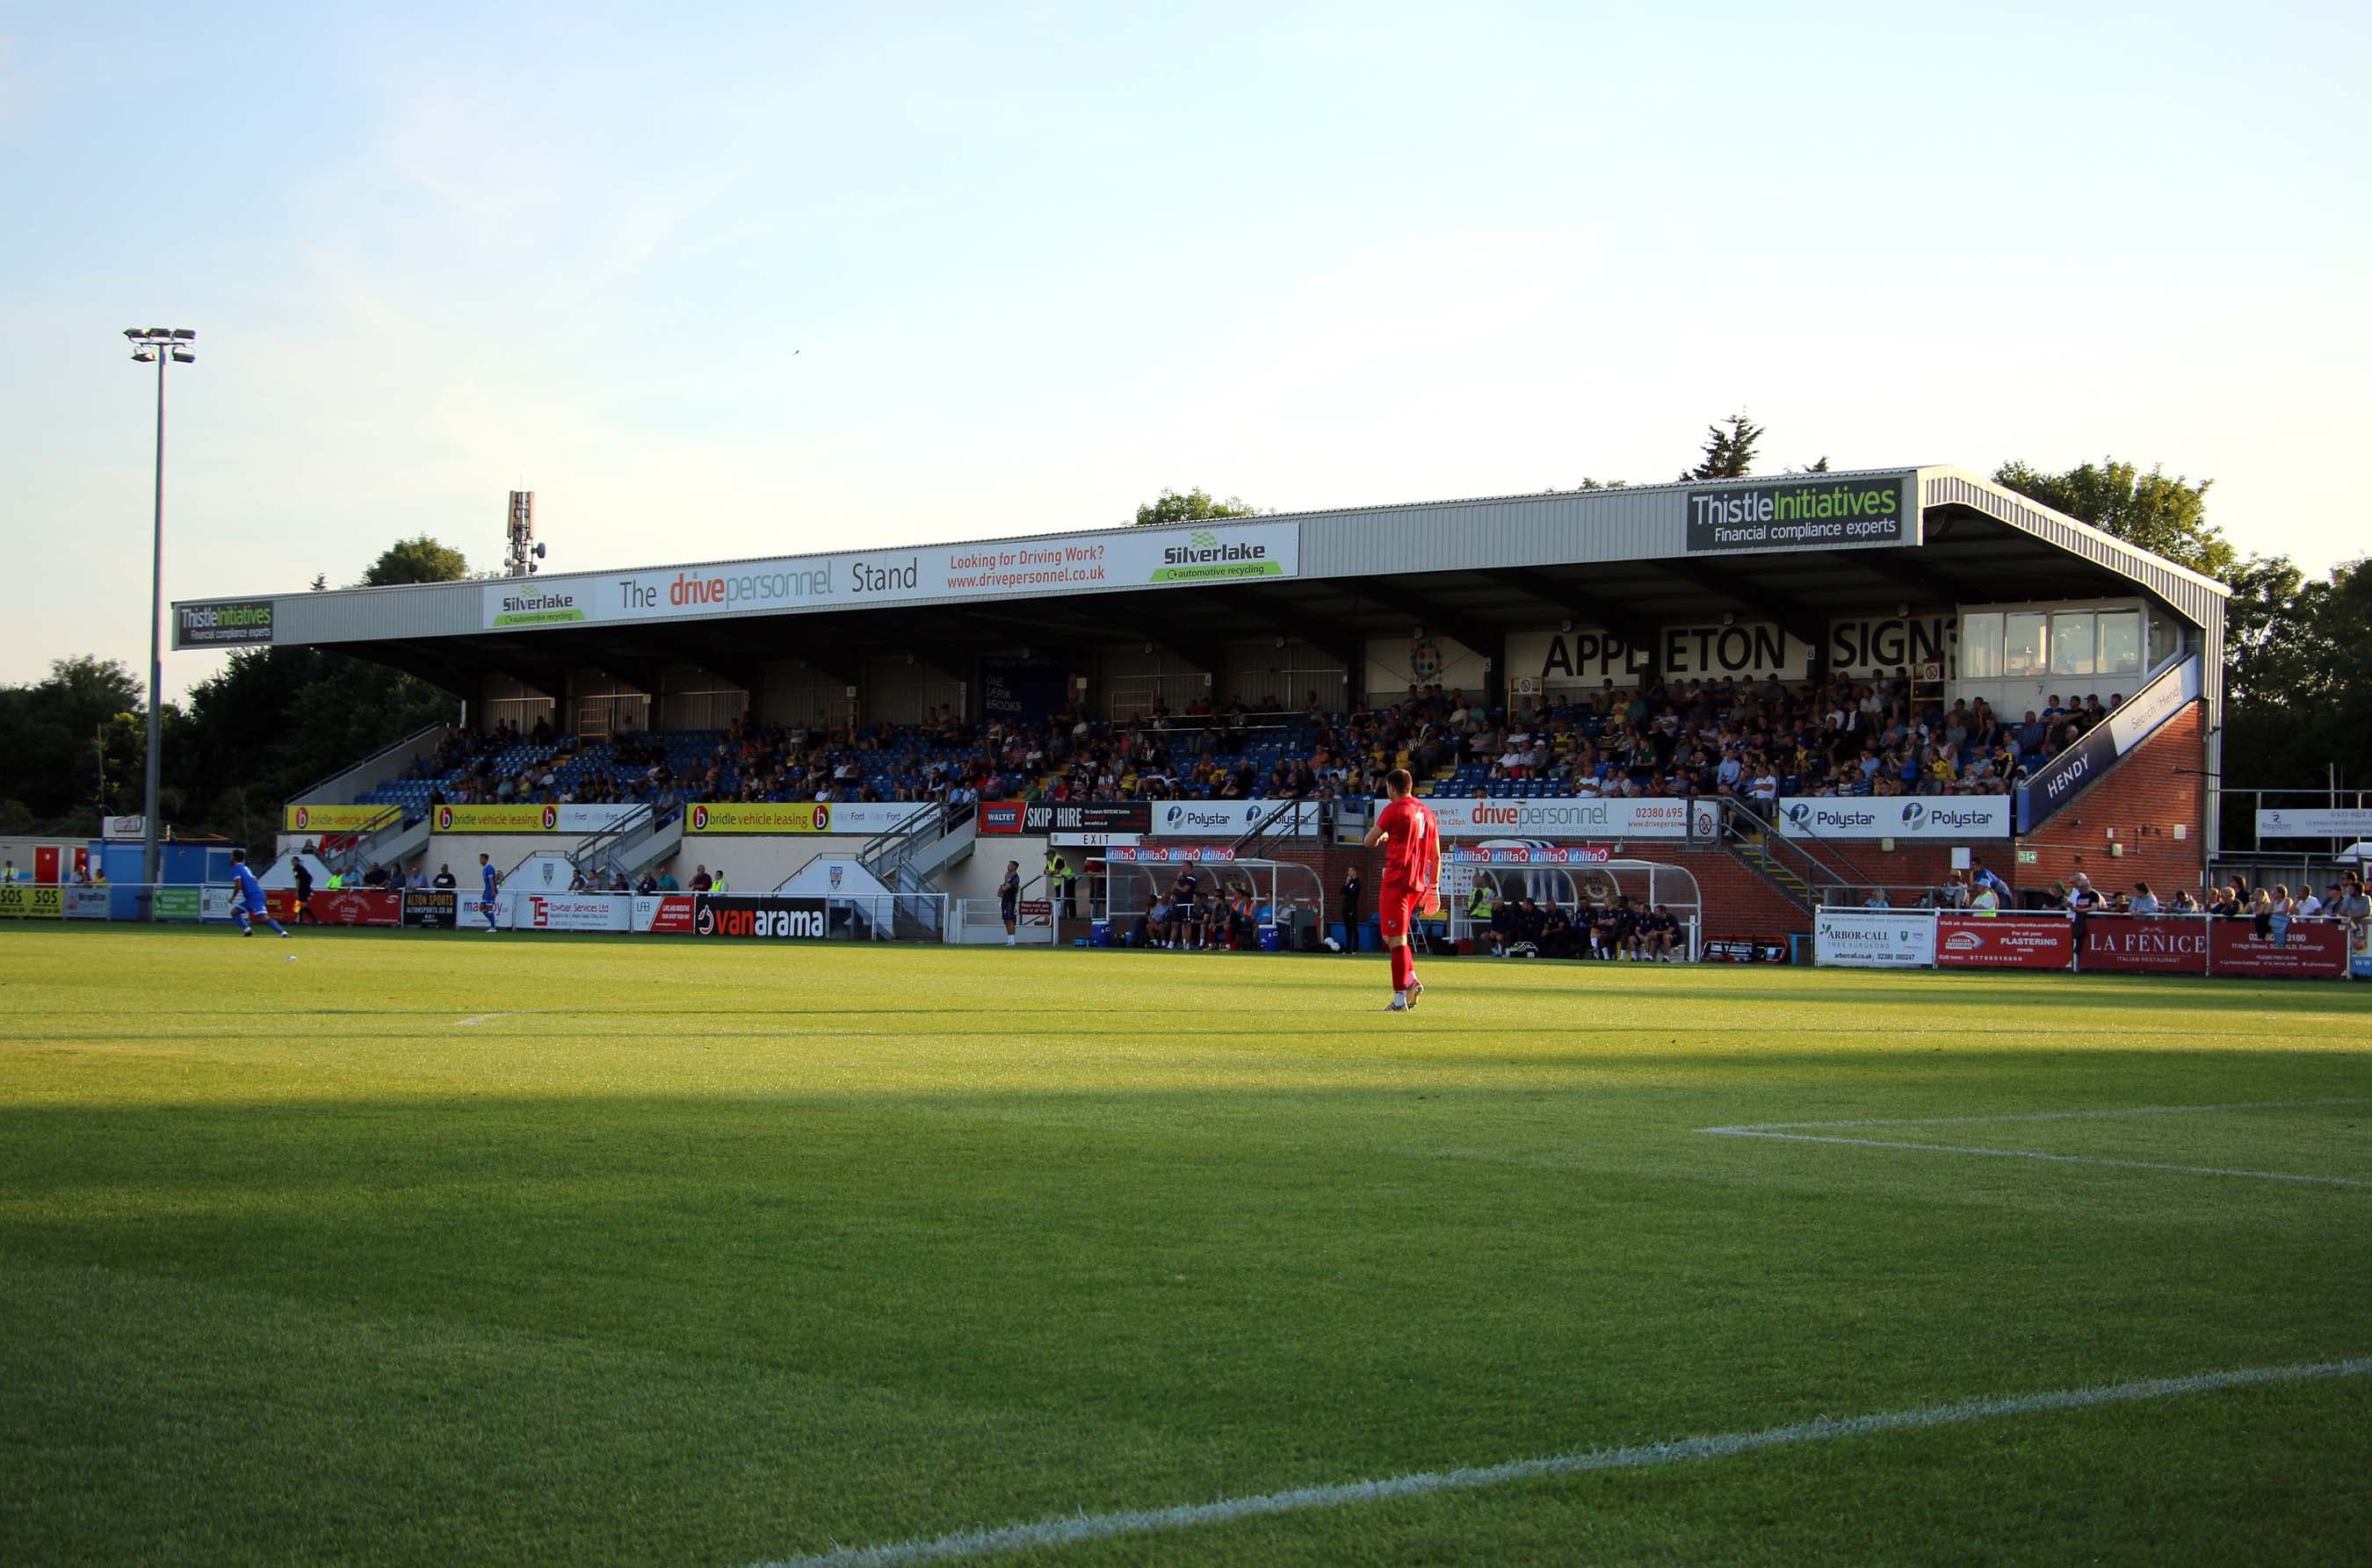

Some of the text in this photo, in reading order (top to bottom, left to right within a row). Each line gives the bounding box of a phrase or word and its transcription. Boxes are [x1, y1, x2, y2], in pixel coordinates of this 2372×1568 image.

[1692, 486, 1896, 525] ThistleInitiatives
[1715, 517, 1896, 542] Financial compliance experts
[951, 545, 1104, 570] Looking for Driving Work?
[1164, 543, 1265, 565] Silverlake
[947, 566, 1104, 589] www.drivepersonnel.co.uk
[1178, 565, 1264, 578] automotive recycling
[619, 579, 656, 609] The
[851, 557, 917, 593] Stand
[503, 594, 573, 611] Silverlake
[181, 604, 271, 628] ThistleInitiatives
[546, 613, 573, 622] recycling
[191, 627, 271, 640] Financial compliance experts
[2047, 753, 2089, 798] HENDY
[987, 813, 1016, 822] WALTET
[1027, 807, 1082, 827] SKIP HIRE
[1187, 812, 1231, 827] Polystar
[1472, 801, 1609, 830] drivepersonnel
[1636, 807, 1664, 818] 02380
[1666, 807, 1683, 818] 695
[1817, 811, 1876, 828] Polystar
[1932, 810, 1992, 828] Polystar
[454, 813, 539, 828] bridle vehicle leasing
[710, 813, 808, 829] bridle vehicle leasing
[1083, 835, 1110, 844] EXIT
[1106, 849, 1129, 860] utilita
[1137, 849, 1161, 860] utilita
[1169, 849, 1192, 860] utilita
[1202, 849, 1226, 860] utilita
[1454, 849, 1482, 862] utilita
[1492, 849, 1519, 862] utilita
[1530, 849, 1558, 862] utilita
[1569, 849, 1598, 862] utilita
[1, 889, 23, 903] SOS
[34, 890, 58, 904] SOS
[407, 893, 453, 906] ALTON SPORTS
[550, 902, 610, 913] Towbar Services Ltd
[716, 908, 824, 937] vanarama
[1827, 930, 1890, 941] ARBOR-CALL
[2000, 937, 2057, 946] PLASTERING
[2090, 933, 2206, 953] LA FENICE
